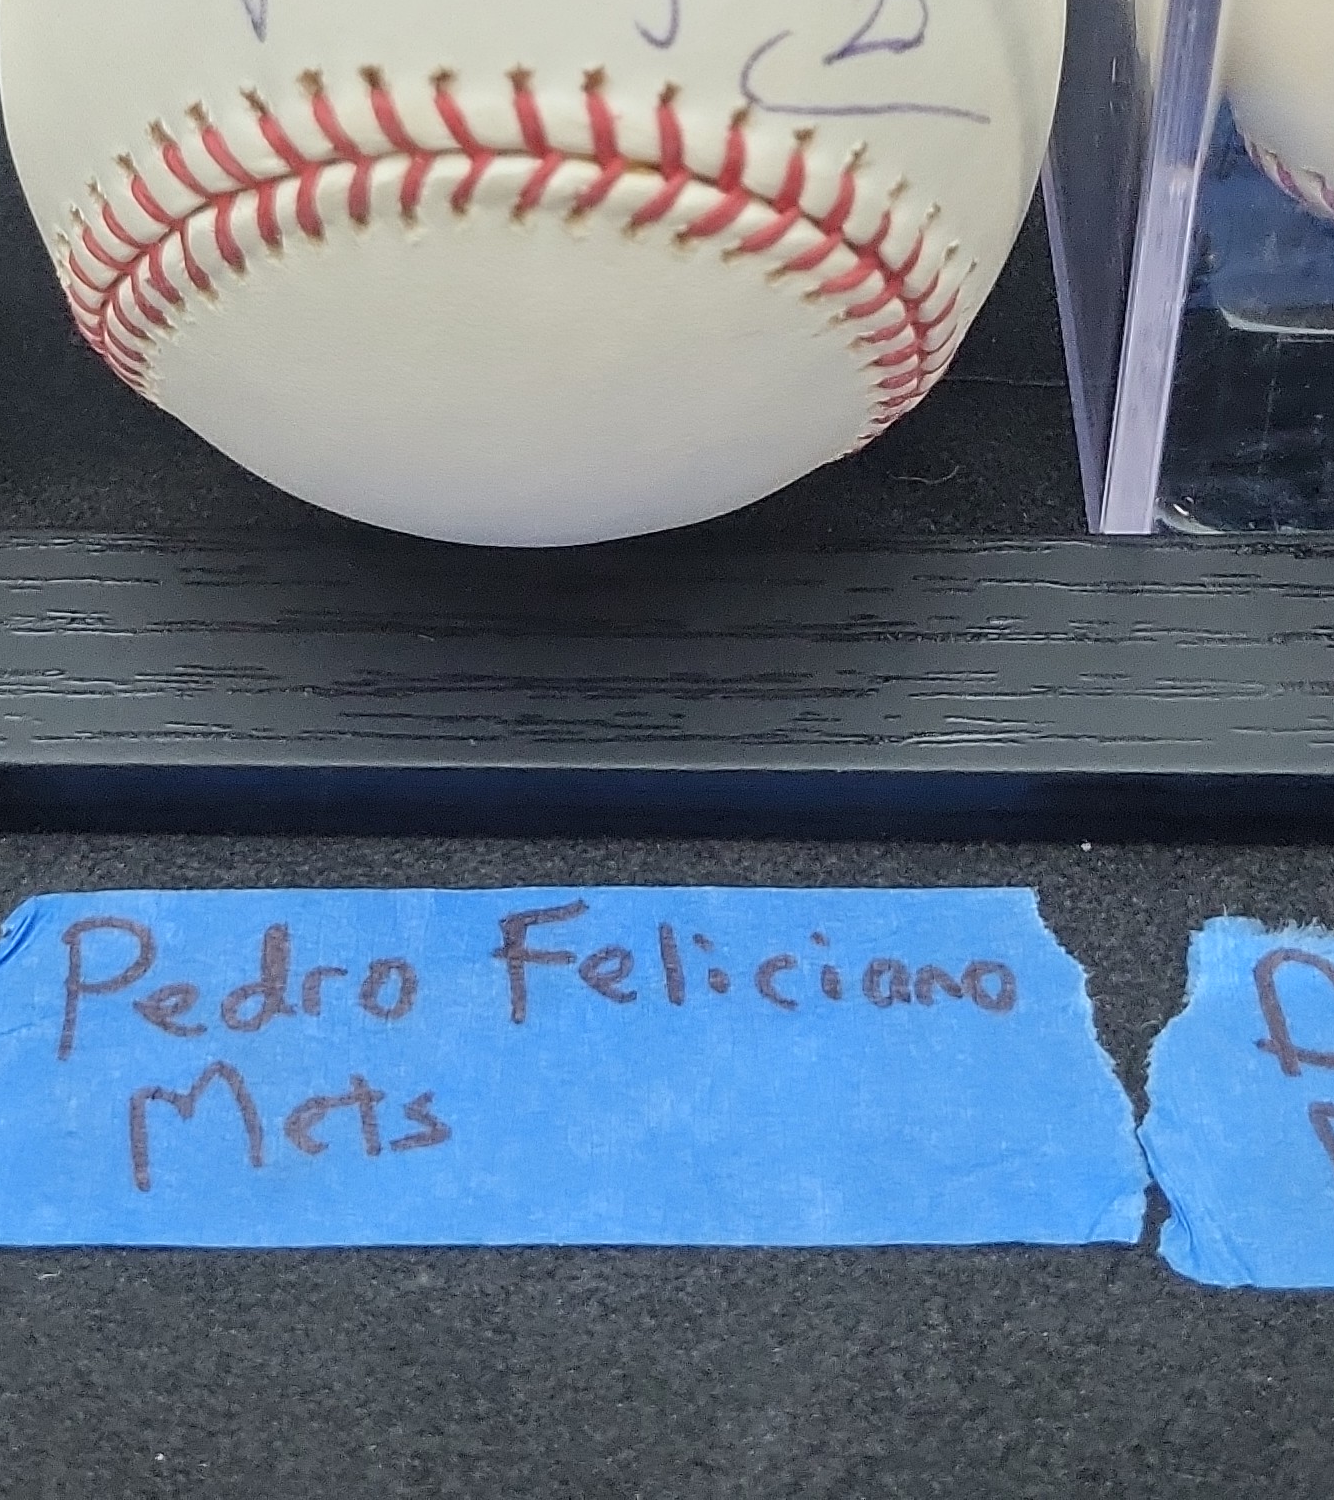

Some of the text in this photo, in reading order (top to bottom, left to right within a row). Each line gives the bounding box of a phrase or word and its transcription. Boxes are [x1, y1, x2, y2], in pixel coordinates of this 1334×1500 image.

[57, 899, 1017, 1062] Pedro Feliciano
[128, 1060, 453, 1193] Mets
